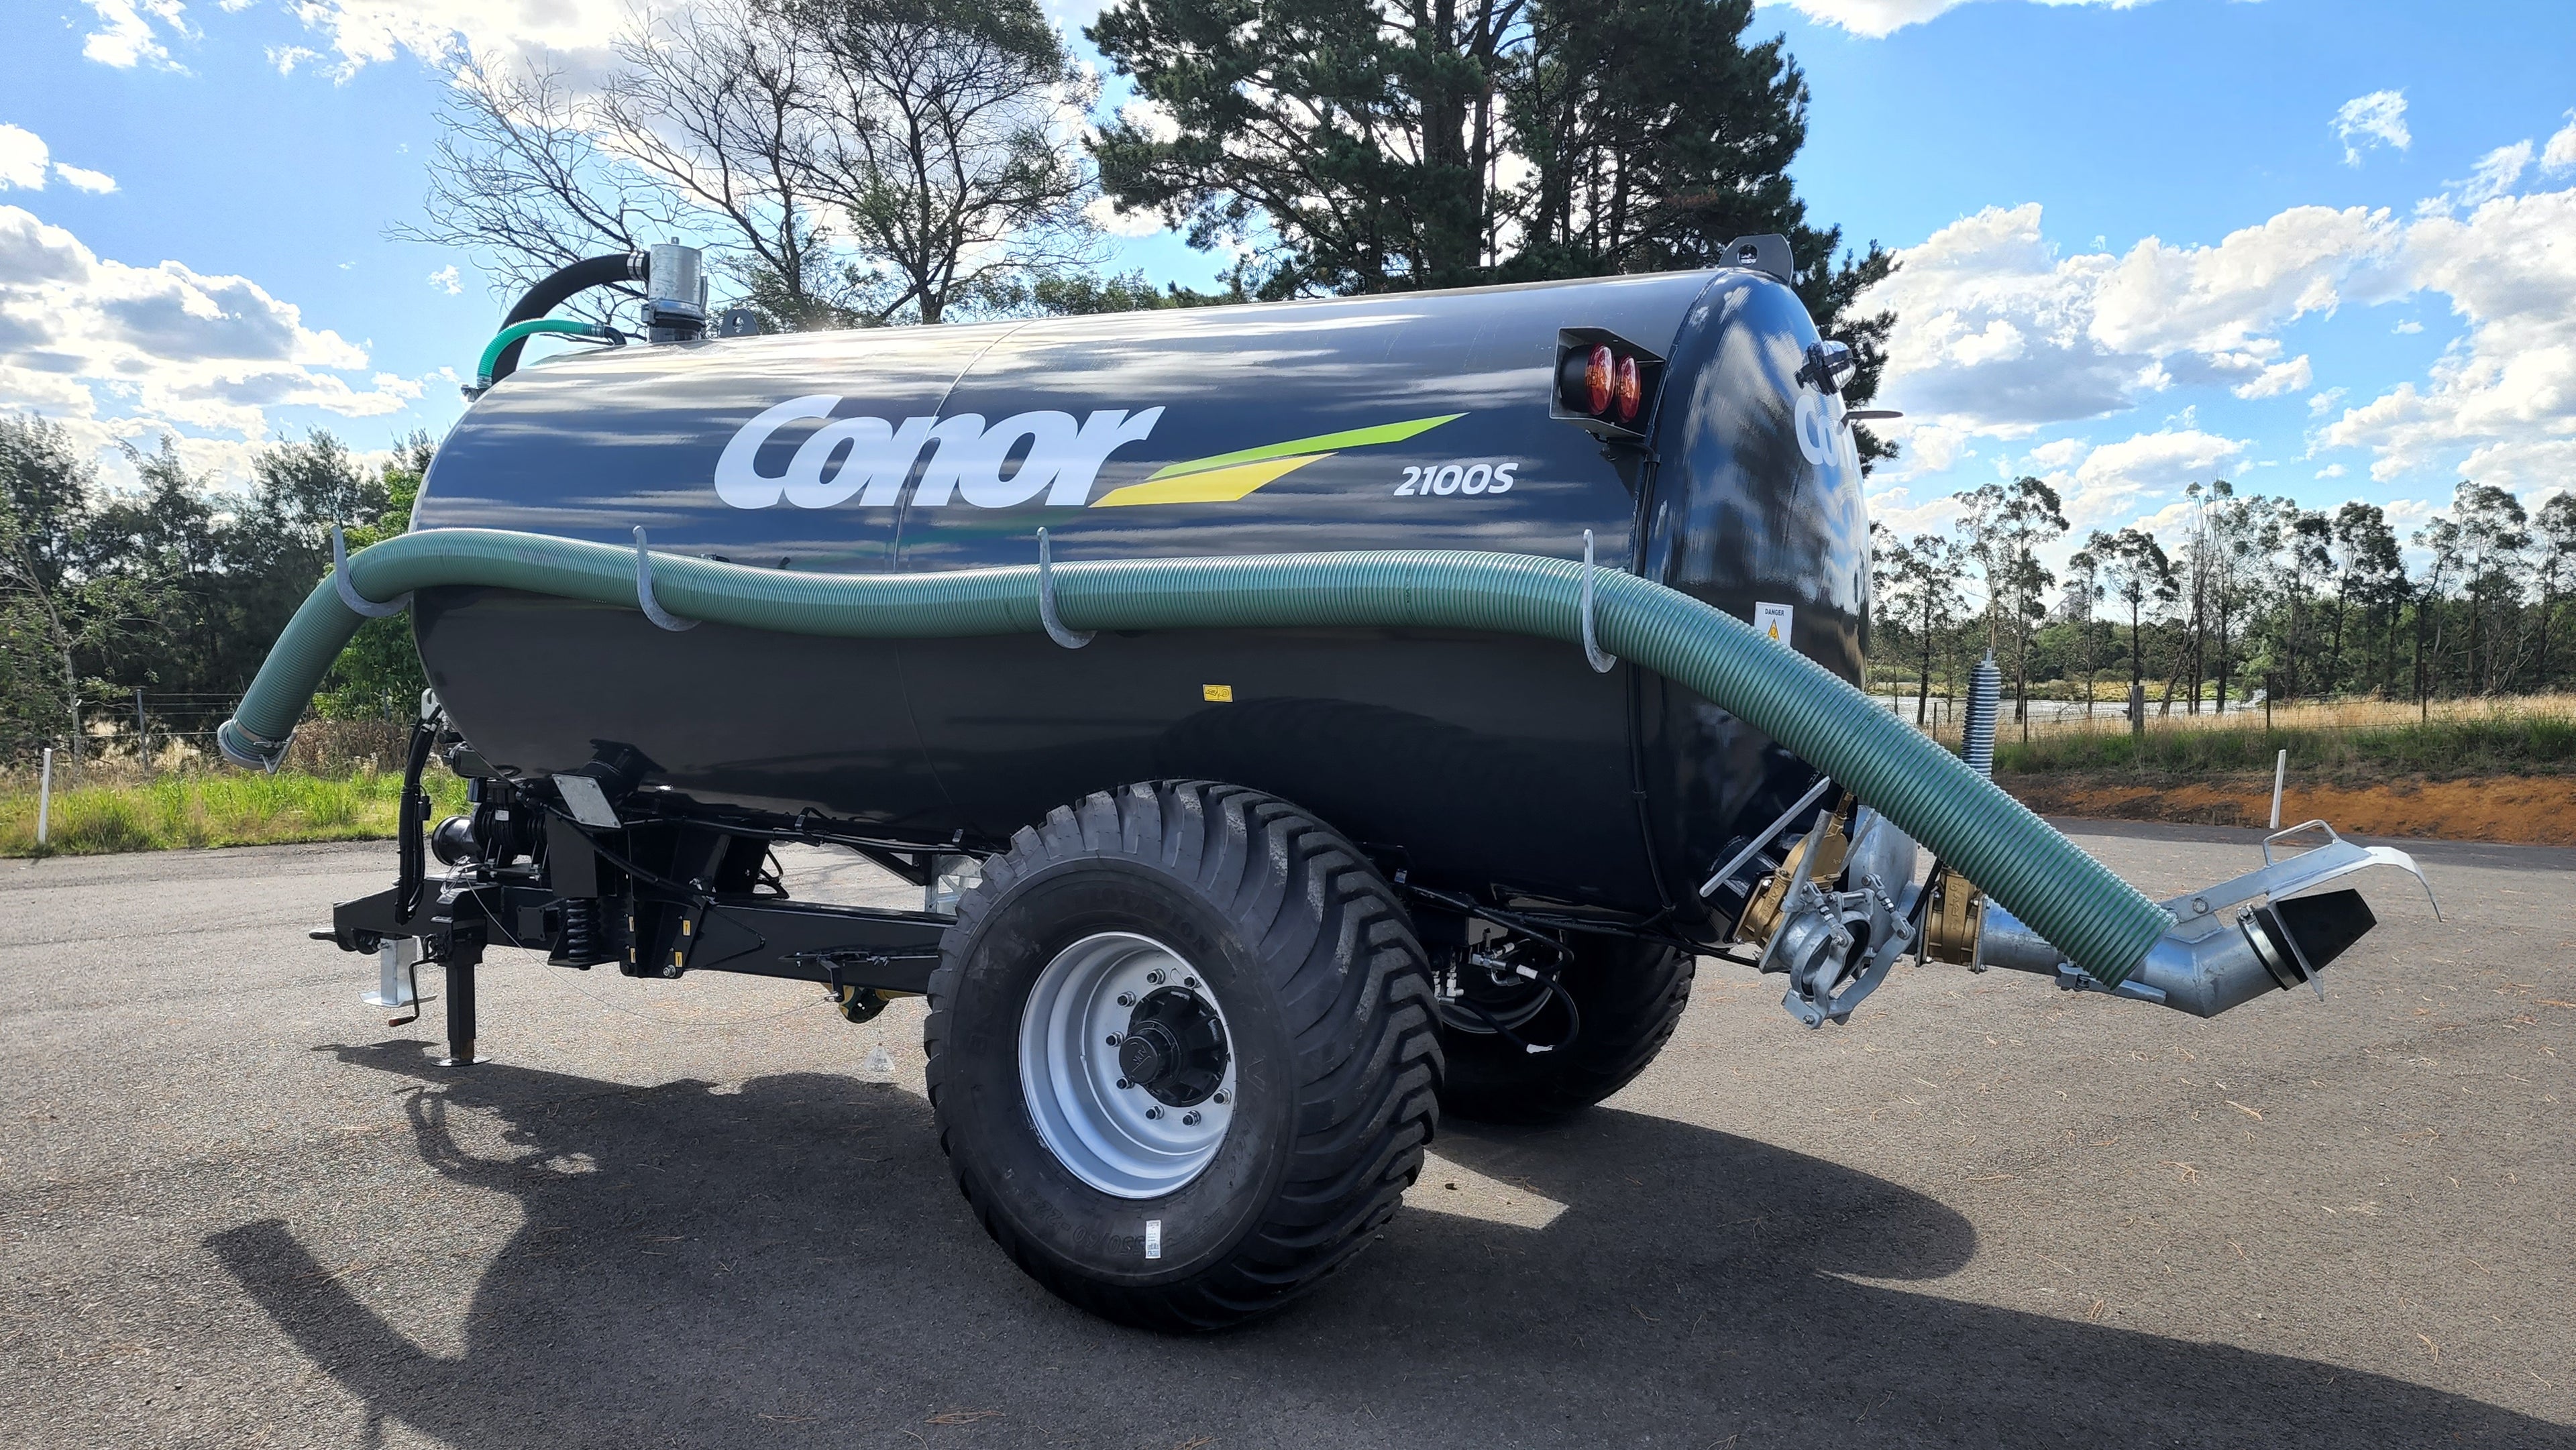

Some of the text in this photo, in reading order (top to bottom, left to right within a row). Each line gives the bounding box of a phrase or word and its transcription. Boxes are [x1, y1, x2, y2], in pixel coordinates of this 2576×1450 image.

[714, 394, 1166, 509] Conor
[1393, 463, 1519, 496] 2100S
[1765, 608, 1785, 616] DANGER
